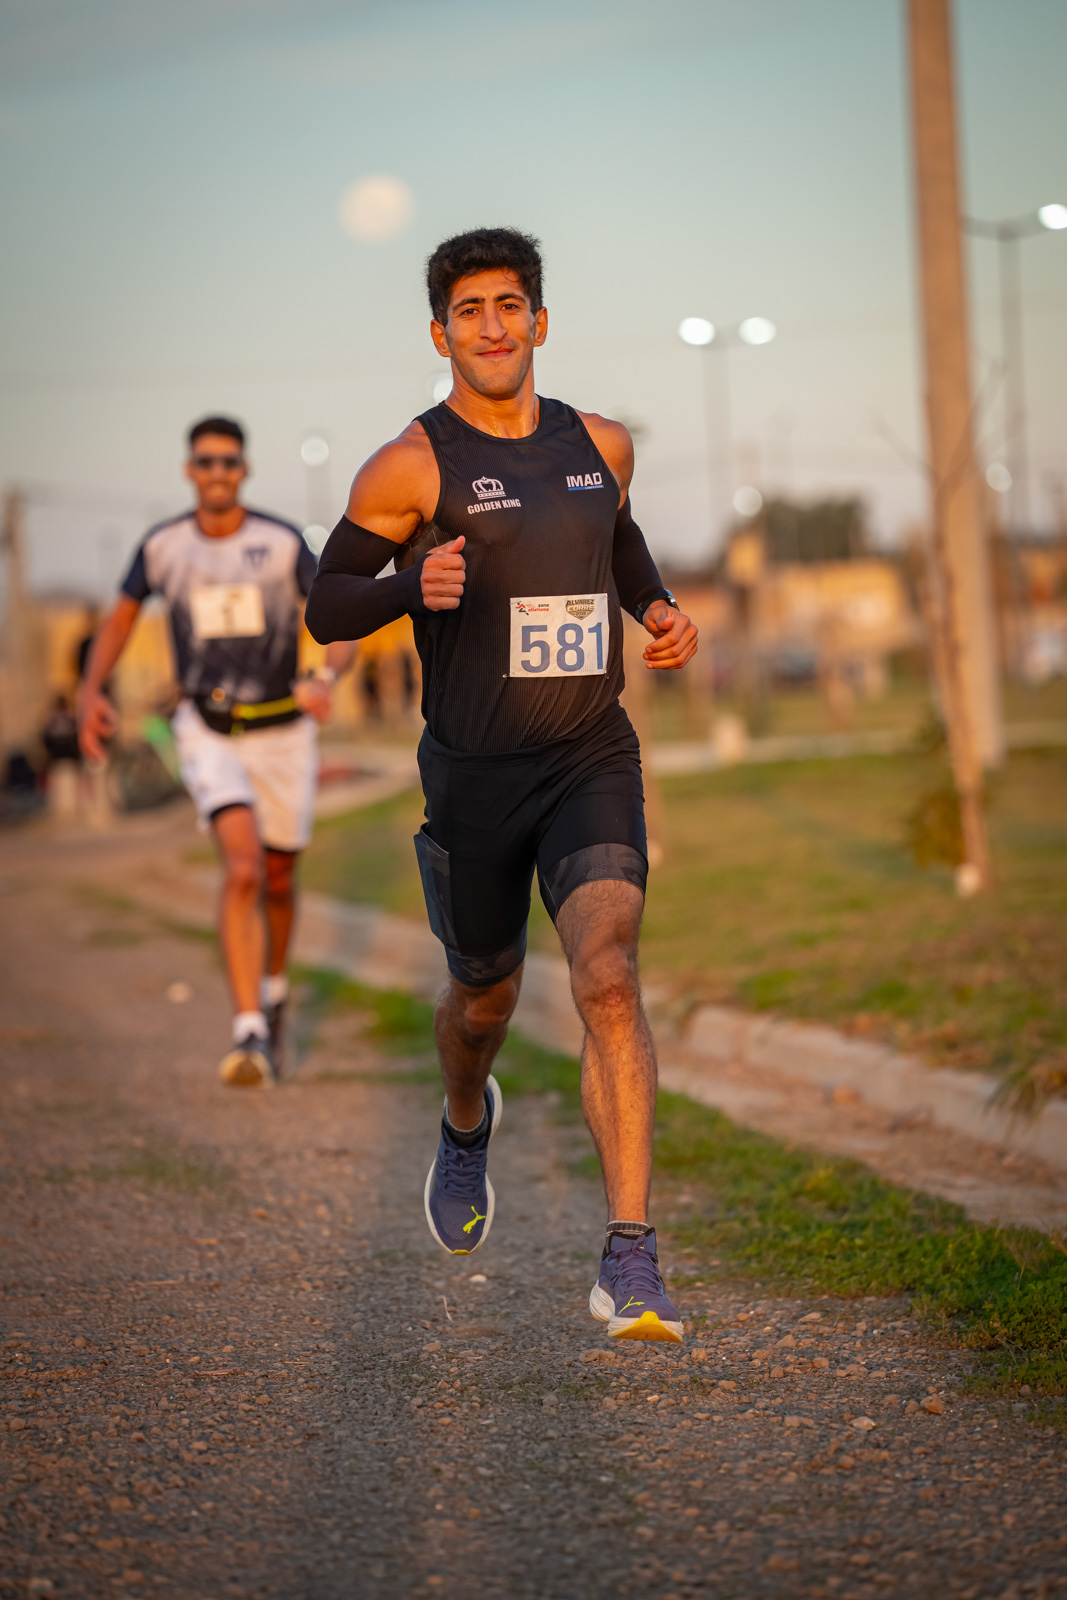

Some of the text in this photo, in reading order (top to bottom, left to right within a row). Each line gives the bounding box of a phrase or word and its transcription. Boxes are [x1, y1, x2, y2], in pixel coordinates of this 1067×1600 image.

[566, 472, 603, 488] IMAD
[467, 498, 521, 514] GOLDEN KING
[520, 621, 604, 673] 581
